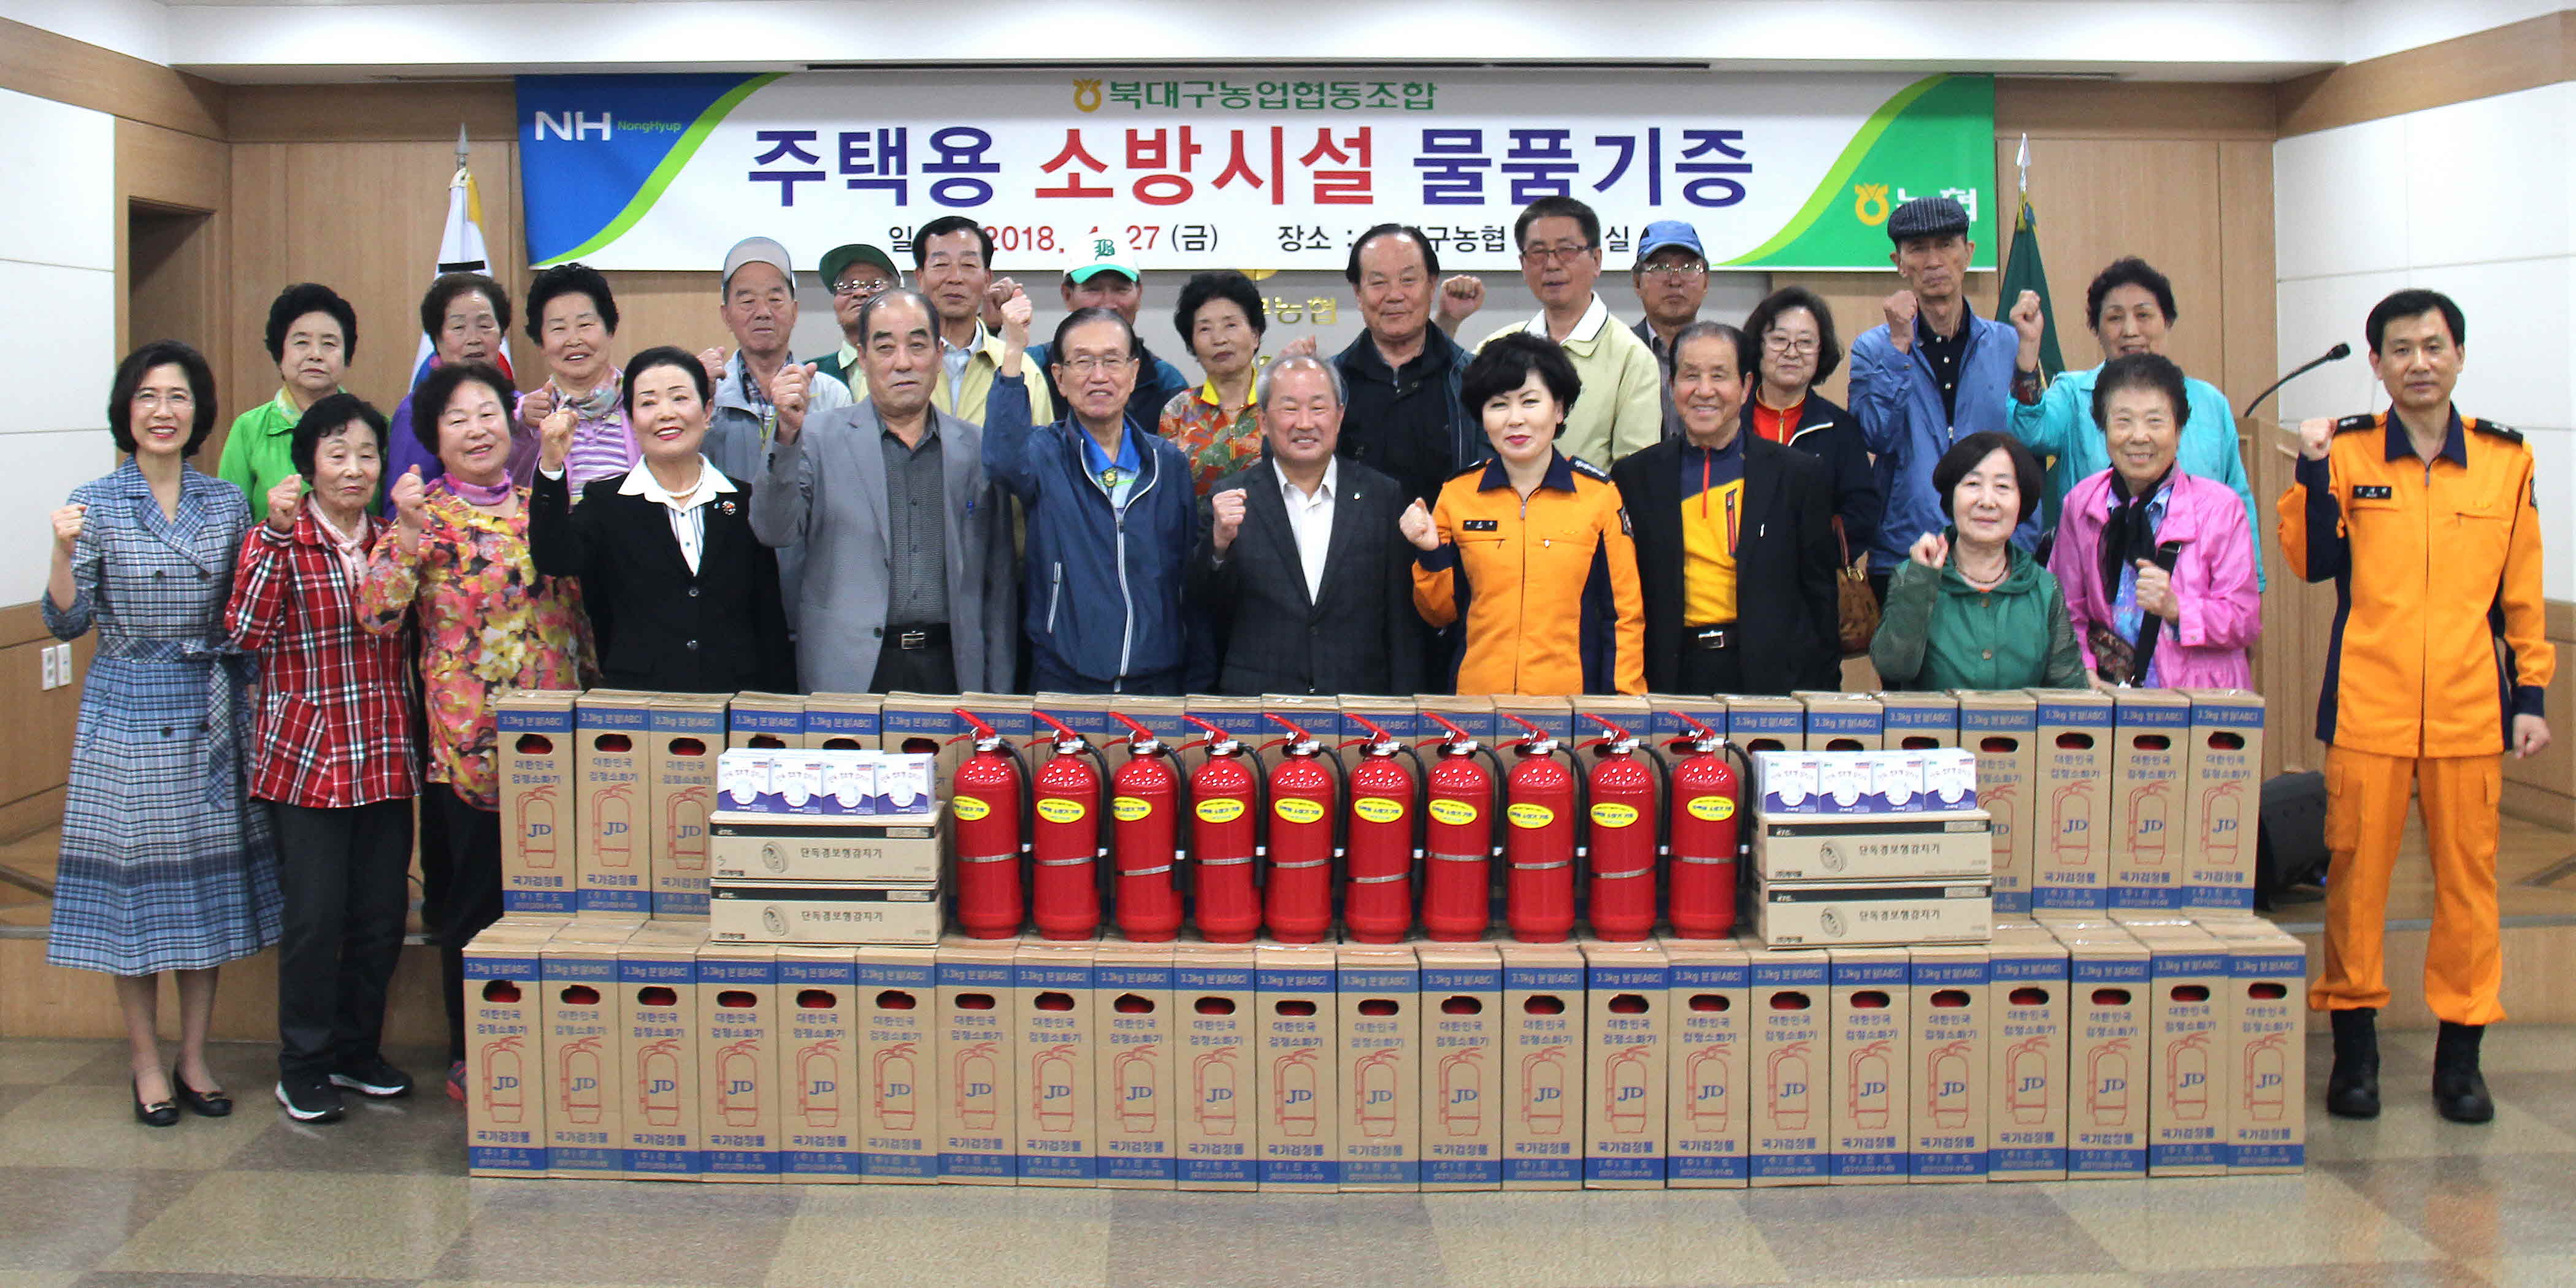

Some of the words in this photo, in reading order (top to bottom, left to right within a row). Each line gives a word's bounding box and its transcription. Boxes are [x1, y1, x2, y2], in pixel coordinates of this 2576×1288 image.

[1109, 80, 1438, 111] 북대구농업협동조합
[535, 110, 611, 141] NH
[618, 120, 683, 133] NongHyup
[748, 126, 1000, 208] 주택용
[1034, 125, 1374, 206] 소방시설
[1413, 127, 1754, 208] 물품기증
[987, 225, 1064, 253] 2018.
[1127, 225, 1160, 250] 27
[1171, 223, 1219, 252] (금)
[1278, 225, 1331, 251] 장소
[1094, 239, 1116, 261] B
[527, 824, 553, 838] JD
[604, 822, 628, 836] JD
[677, 826, 702, 839] JD
[2063, 820, 2087, 834] JD
[2139, 820, 2164, 834] JD
[2212, 818, 2237, 833] JD
[800, 848, 883, 859] 단독경보형감지기
[801, 911, 884, 922] 단독경보형감지기
[492, 1076, 519, 1091] JD
[572, 1078, 597, 1092] JD
[649, 1079, 675, 1095] JD
[727, 1081, 754, 1095] JD
[808, 1081, 835, 1096] JD
[2020, 1077, 2044, 1093] JD
[2099, 1079, 2126, 1094] JD
[2181, 1074, 2206, 1088] JD
[2256, 1074, 2279, 1089] JD
[886, 1084, 911, 1098] JD
[966, 1084, 992, 1098] JD
[1045, 1085, 1070, 1100] JD
[1126, 1086, 1152, 1102] JD
[1206, 1089, 1233, 1103] JD
[1452, 1089, 1479, 1105] JD
[1534, 1088, 1561, 1103] JD
[1617, 1087, 1645, 1102] JD
[1697, 1085, 1725, 1100] JD
[1781, 1084, 1806, 1098] JD
[1860, 1083, 1886, 1097] JD
[1940, 1082, 1966, 1097] JD
[1286, 1090, 1313, 1105] JD
[1367, 1091, 1393, 1105] JD
